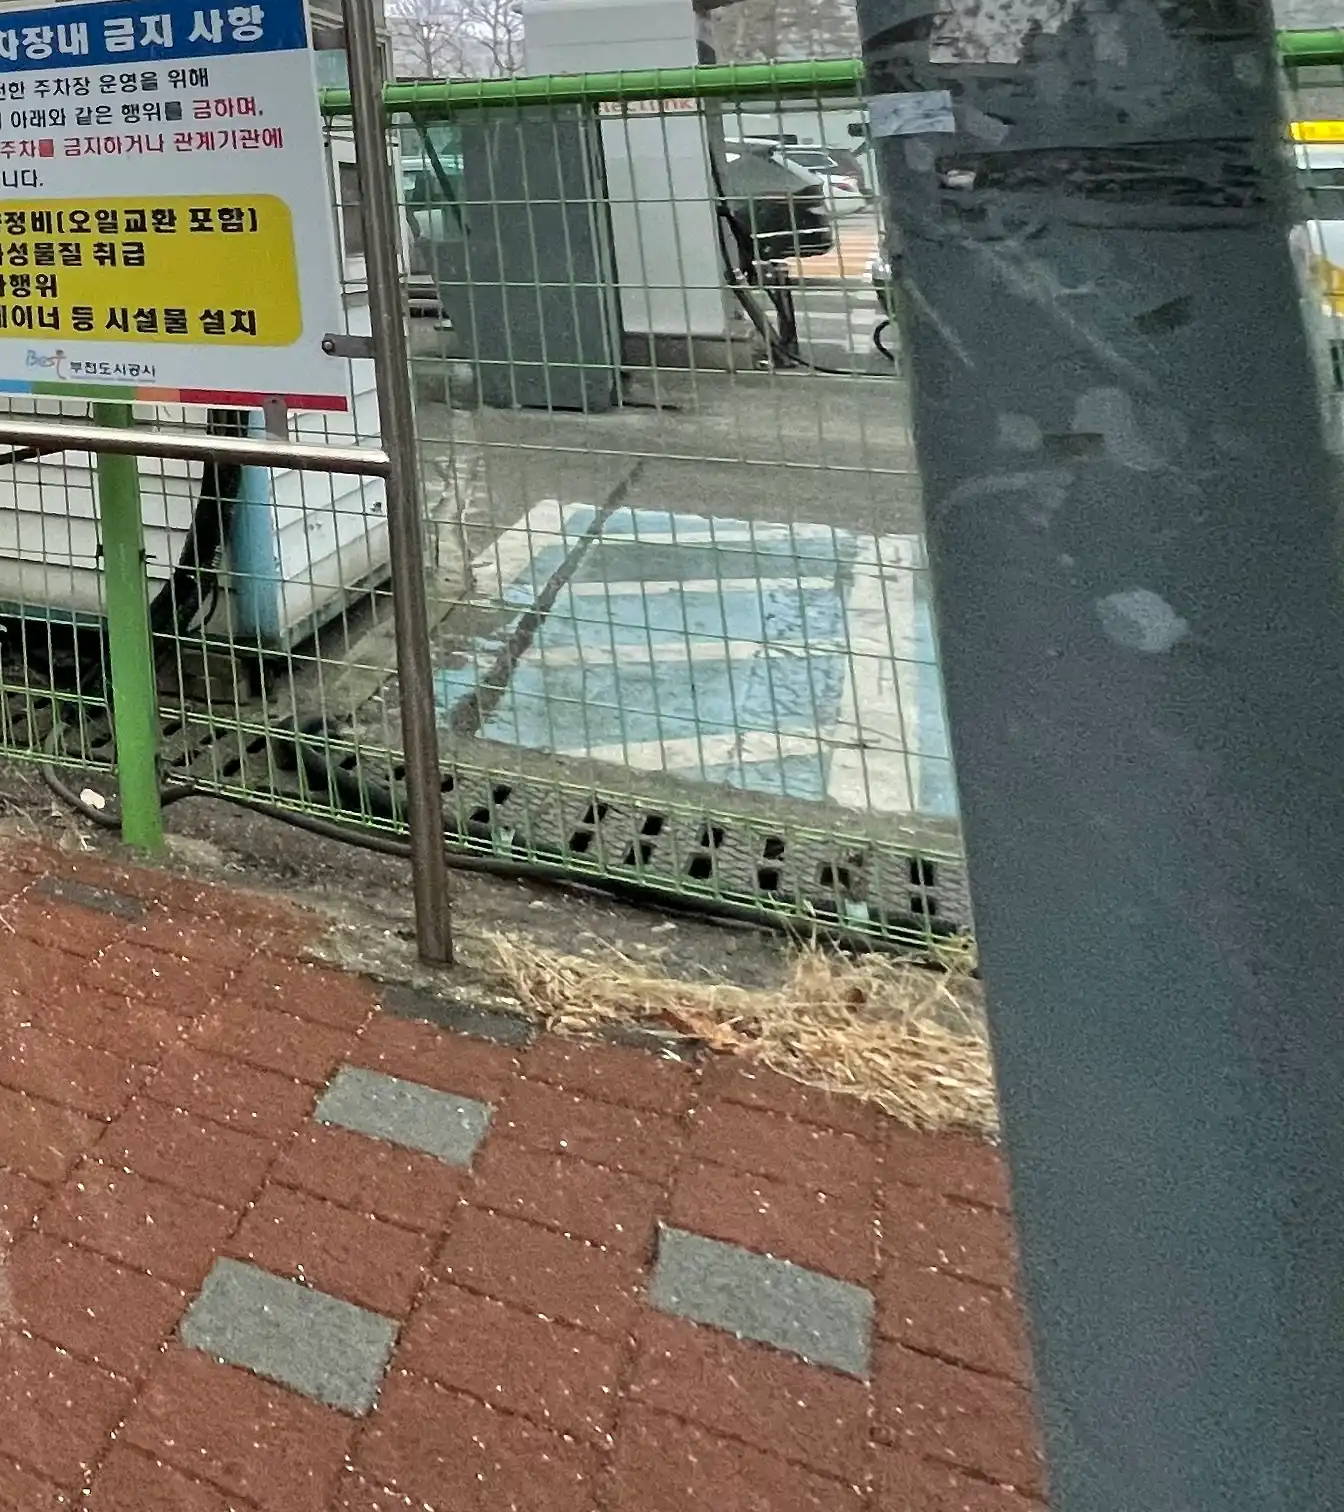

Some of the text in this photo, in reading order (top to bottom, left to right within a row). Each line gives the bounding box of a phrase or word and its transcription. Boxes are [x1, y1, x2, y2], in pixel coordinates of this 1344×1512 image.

[104, 13, 174, 51] 금지
[188, 4, 265, 44] 사항
[34, 76, 91, 99] 주차장
[99, 70, 159, 94] 운영을
[168, 67, 209, 89] 위해
[10, 107, 66, 129] 아래와
[75, 104, 113, 127] 같은
[121, 100, 183, 124] 행위를
[0, 138, 55, 159] 주차를
[64, 132, 164, 157] 금지하거나
[173, 126, 284, 152] 관계기관에
[188, 207, 258, 233] 포함)
[92, 241, 145, 267] 취급
[71, 306, 94, 332] 등
[105, 307, 189, 334] 시설물
[199, 308, 257, 336] 설치
[70, 361, 156, 377] 부천도시공사
